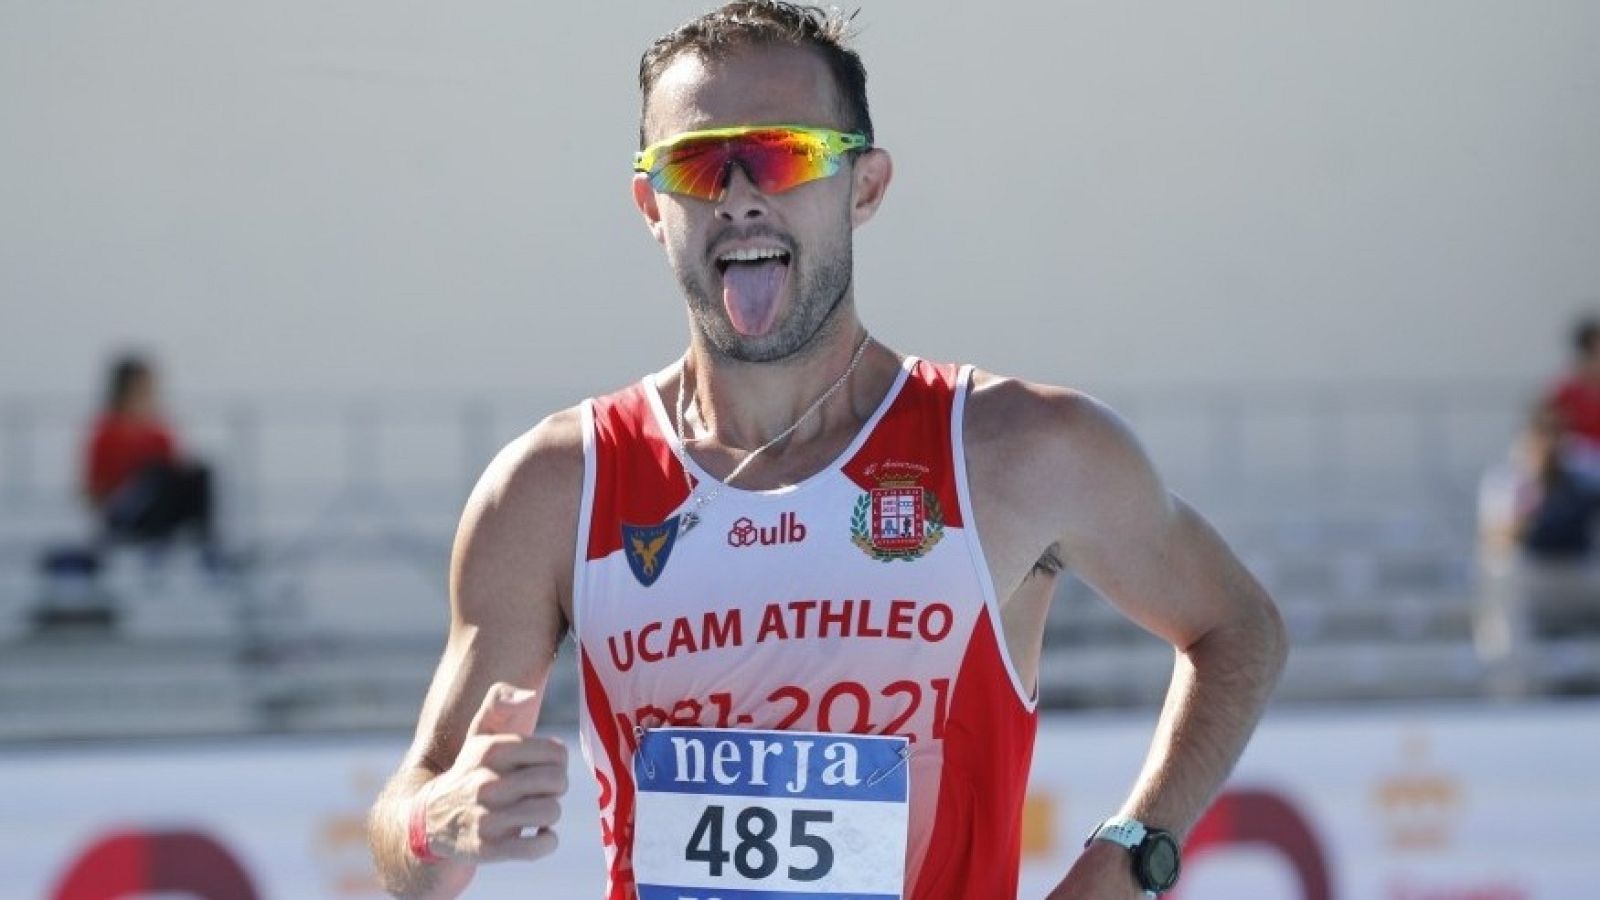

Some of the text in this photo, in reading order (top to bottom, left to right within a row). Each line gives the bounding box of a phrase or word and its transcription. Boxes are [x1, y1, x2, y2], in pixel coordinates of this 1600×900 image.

[760, 511, 806, 546] ulb
[608, 599, 954, 673] UCAM ATHLEO
[616, 678, 950, 754] 11-2021
[670, 736, 862, 793] nerja
[685, 804, 834, 881] 485
